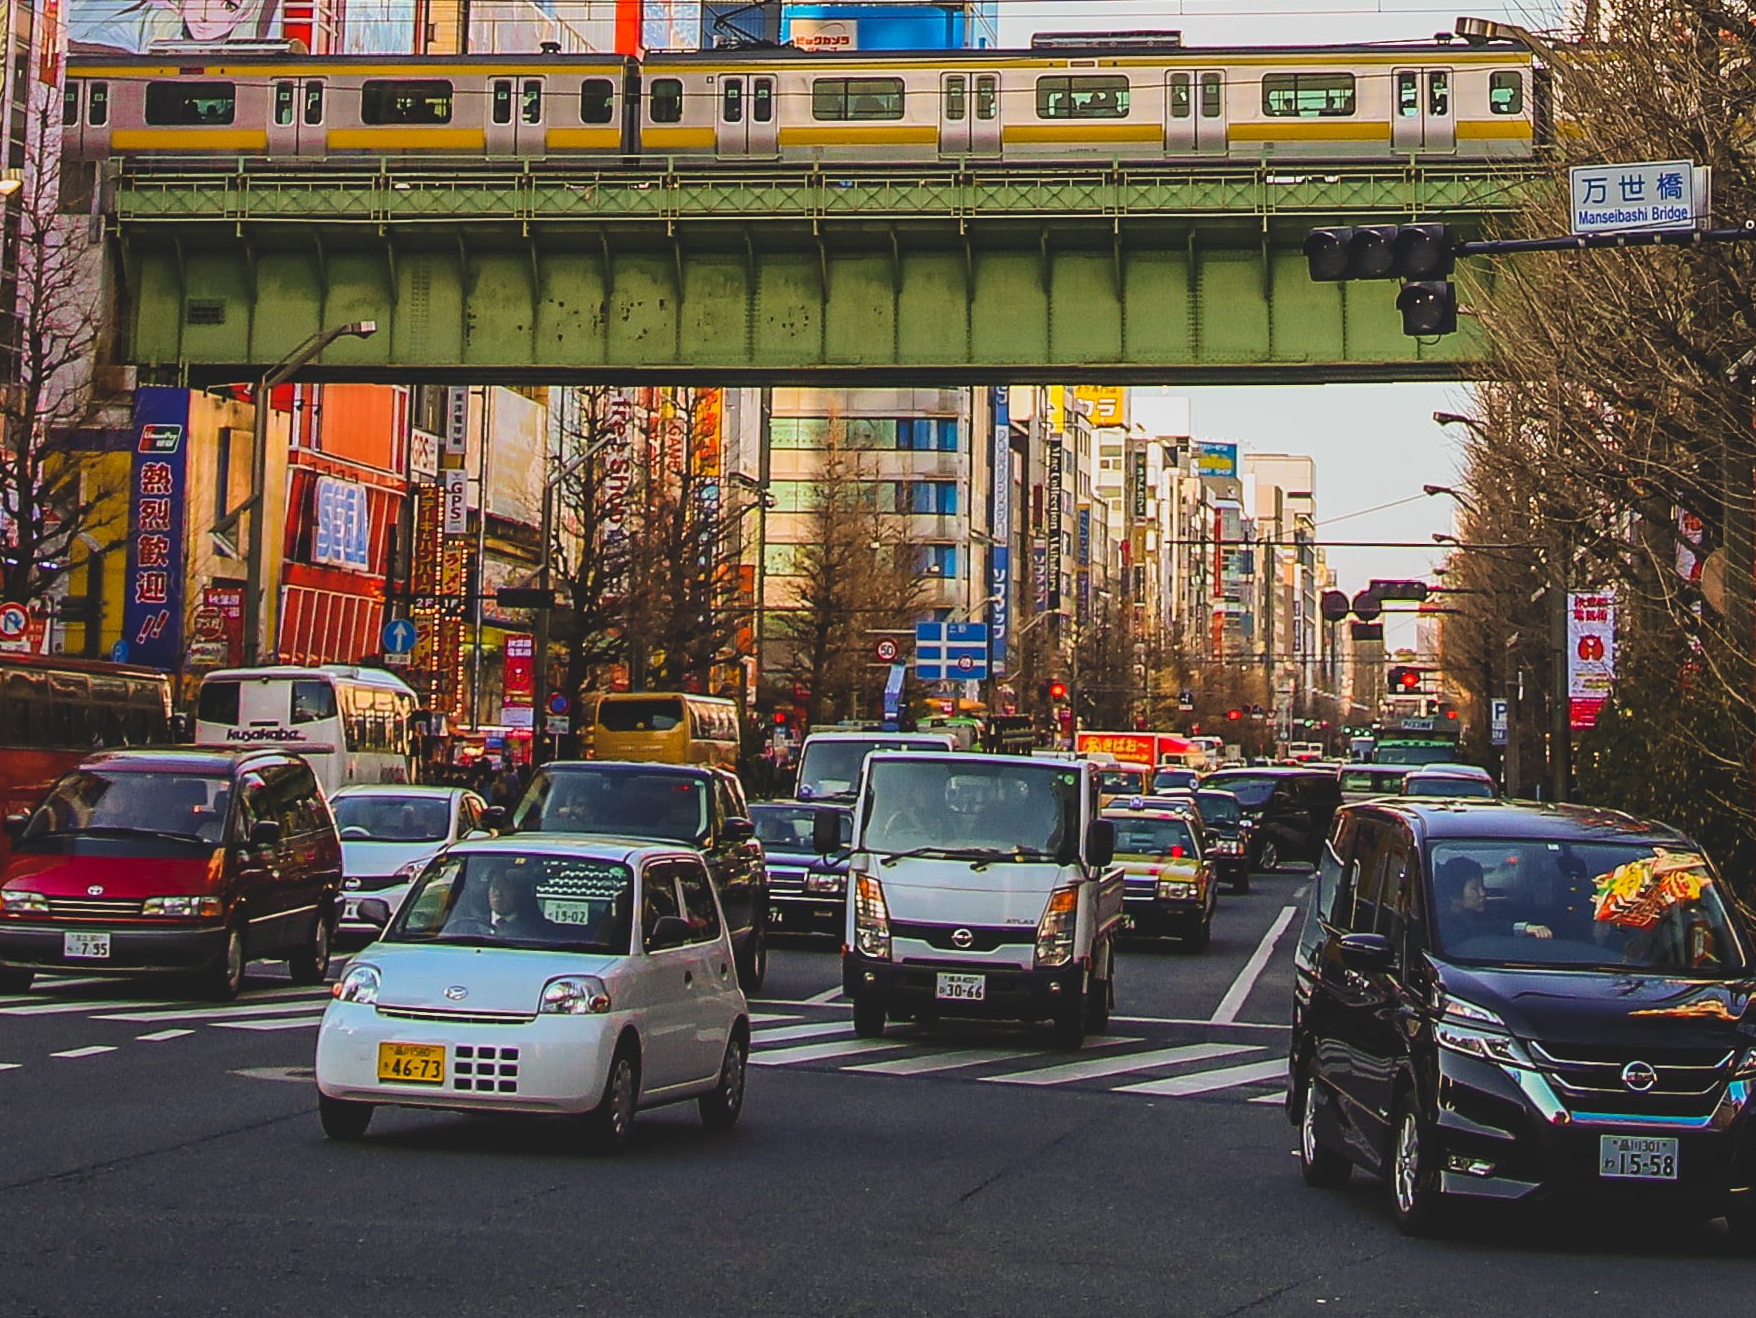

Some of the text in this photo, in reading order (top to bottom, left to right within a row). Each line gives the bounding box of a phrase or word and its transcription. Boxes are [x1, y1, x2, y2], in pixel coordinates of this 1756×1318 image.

[1581, 172, 1684, 206] 万世橋
[1578, 205, 1689, 225] Manseibashi Bridge
[449, 481, 462, 521] GPS
[313, 477, 370, 570] SEGA
[946, 984, 983, 999] 30-66
[392, 1057, 442, 1079] 46-73
[1618, 1153, 1674, 1177] 15-58
